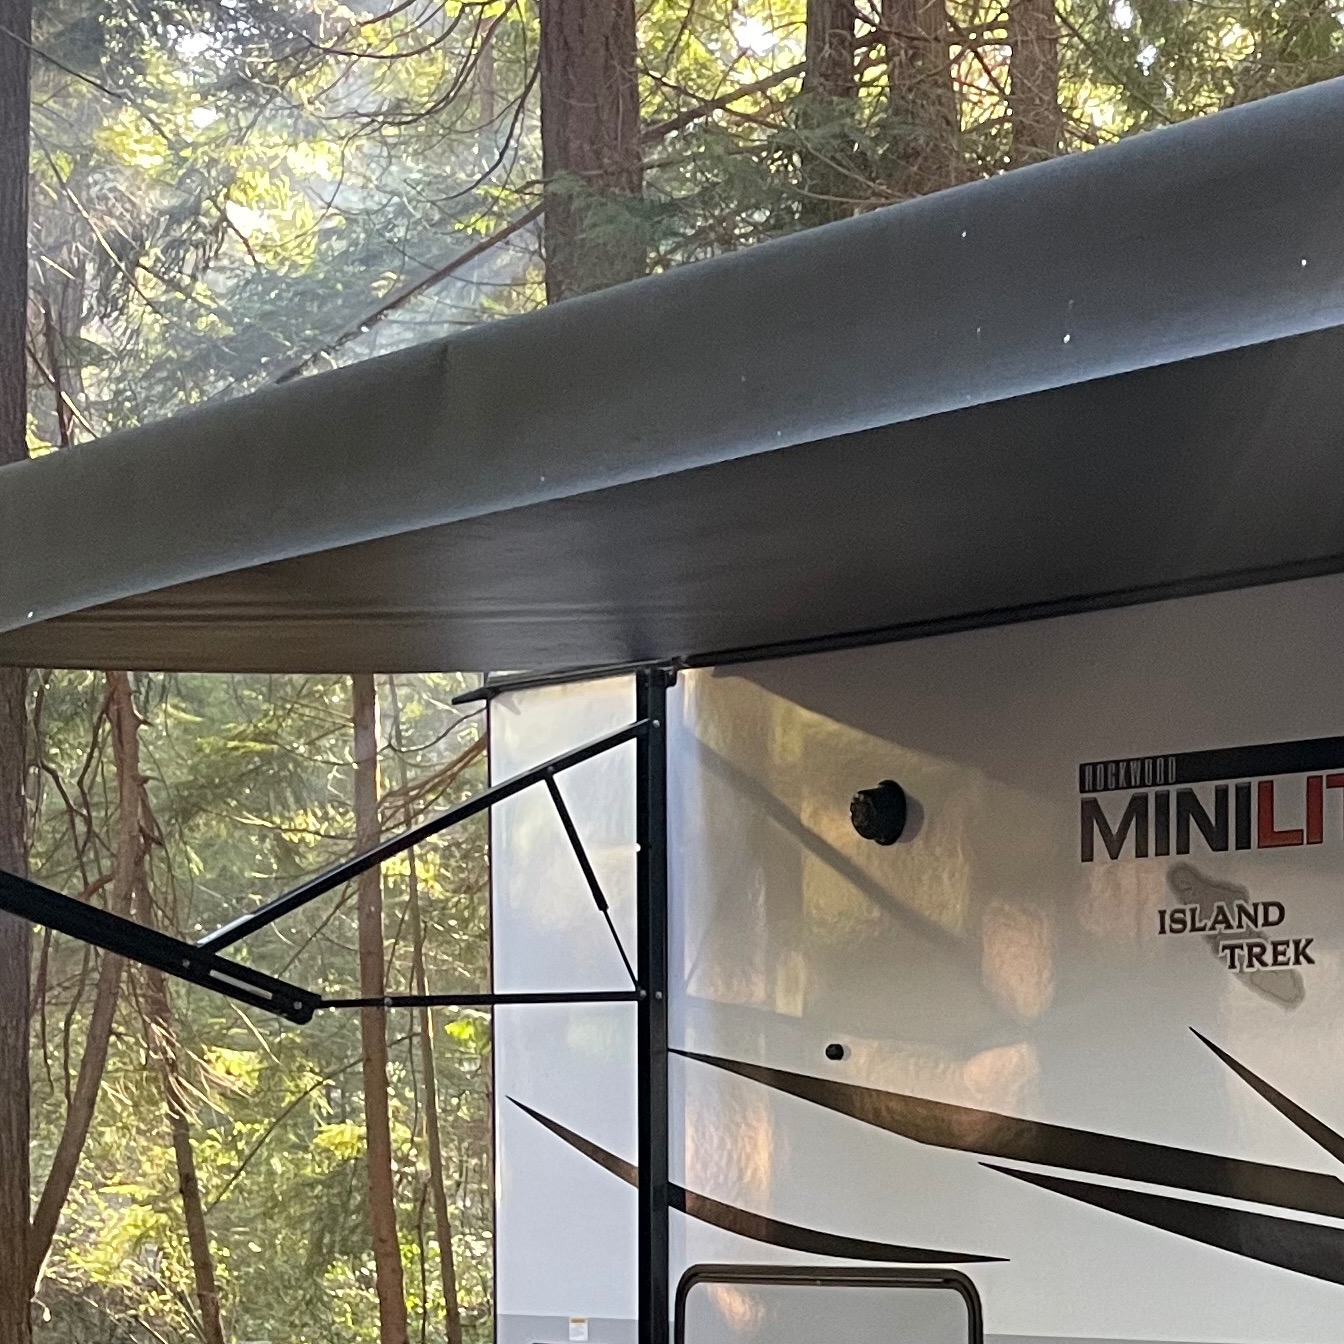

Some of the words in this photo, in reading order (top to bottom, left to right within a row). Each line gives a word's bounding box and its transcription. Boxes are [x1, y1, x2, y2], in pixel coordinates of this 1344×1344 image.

[1085, 757, 1176, 792] ROCKWOOD
[1157, 900, 1286, 936] ISLAND
[1218, 937, 1316, 970] TREK
